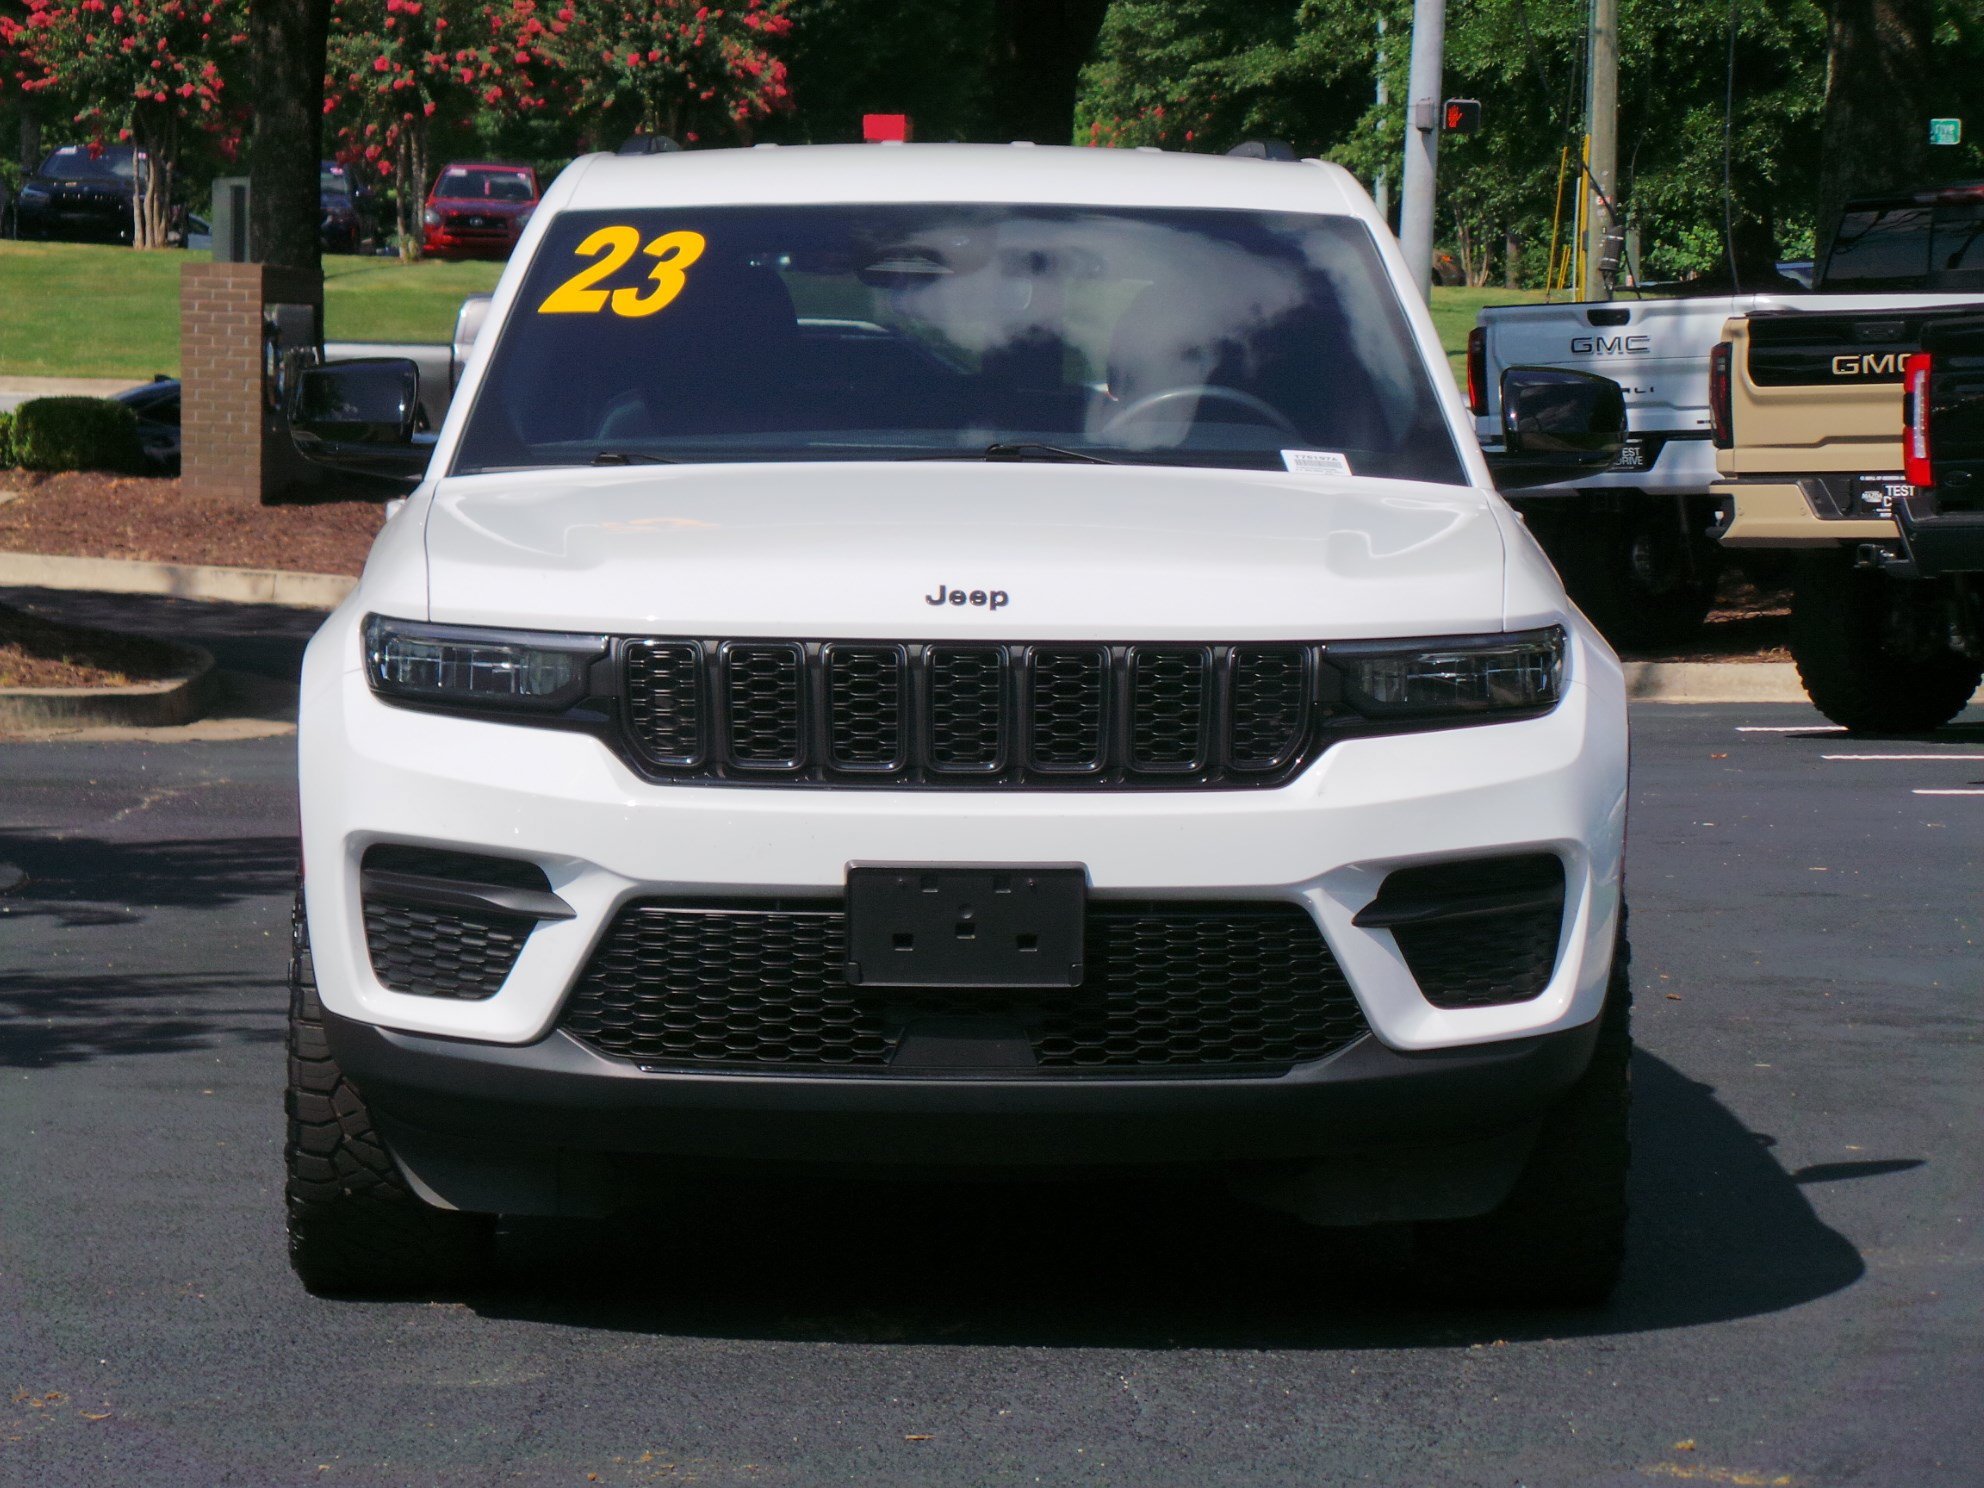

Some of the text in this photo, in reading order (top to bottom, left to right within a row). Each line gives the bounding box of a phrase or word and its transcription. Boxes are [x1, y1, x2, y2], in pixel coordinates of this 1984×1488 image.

[537, 225, 706, 318] 23
[1571, 335, 1650, 354] GMC
[1622, 447, 1641, 457] EST
[1885, 485, 1915, 496] TEST
[925, 584, 1010, 611] Jeep
